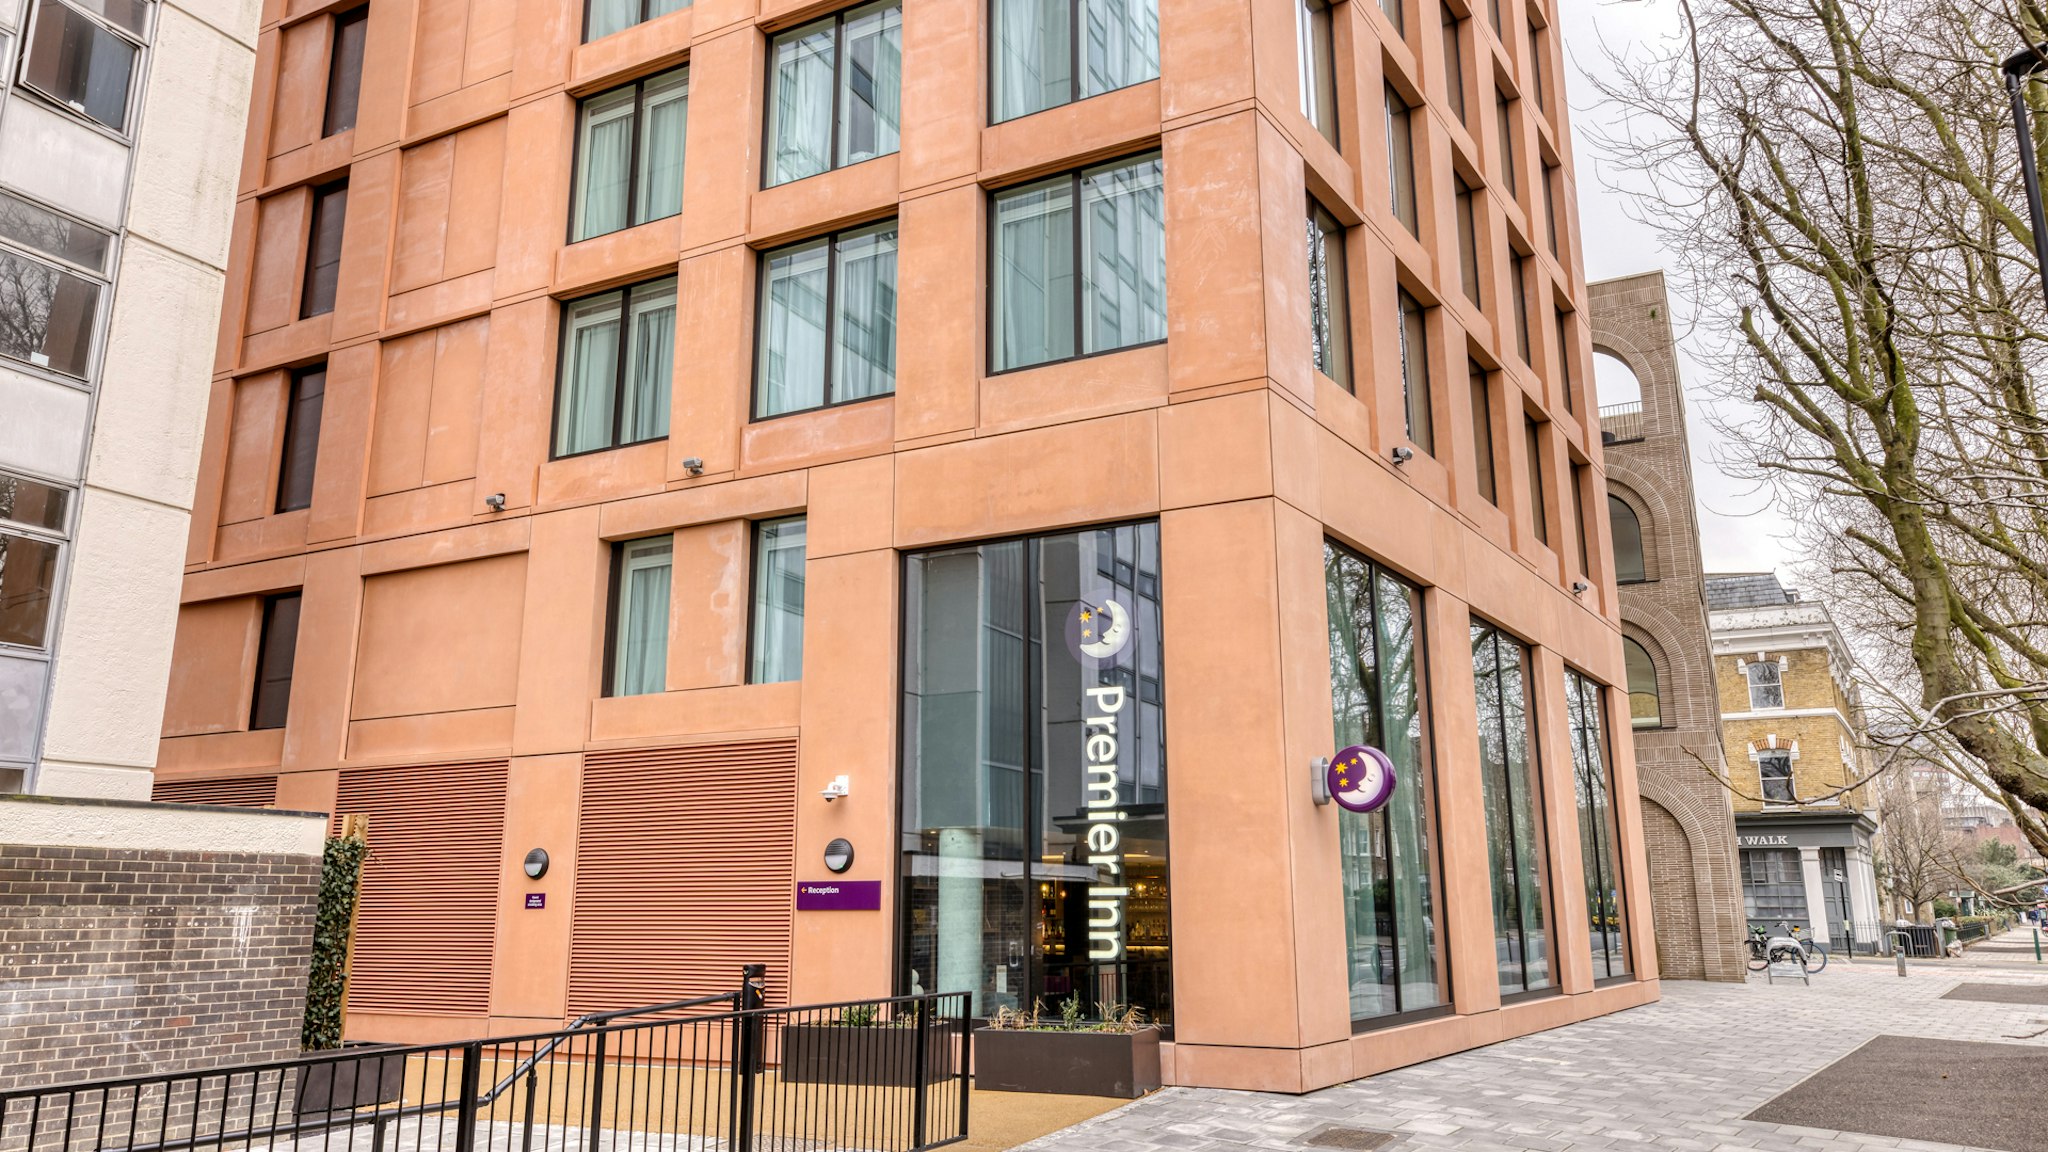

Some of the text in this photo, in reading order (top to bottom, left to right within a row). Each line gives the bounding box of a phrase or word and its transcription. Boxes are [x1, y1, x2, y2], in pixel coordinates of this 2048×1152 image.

[1087, 686, 1129, 959] Premier Inn
[1745, 835, 1788, 846] WALK
[808, 886, 839, 895] Reception
